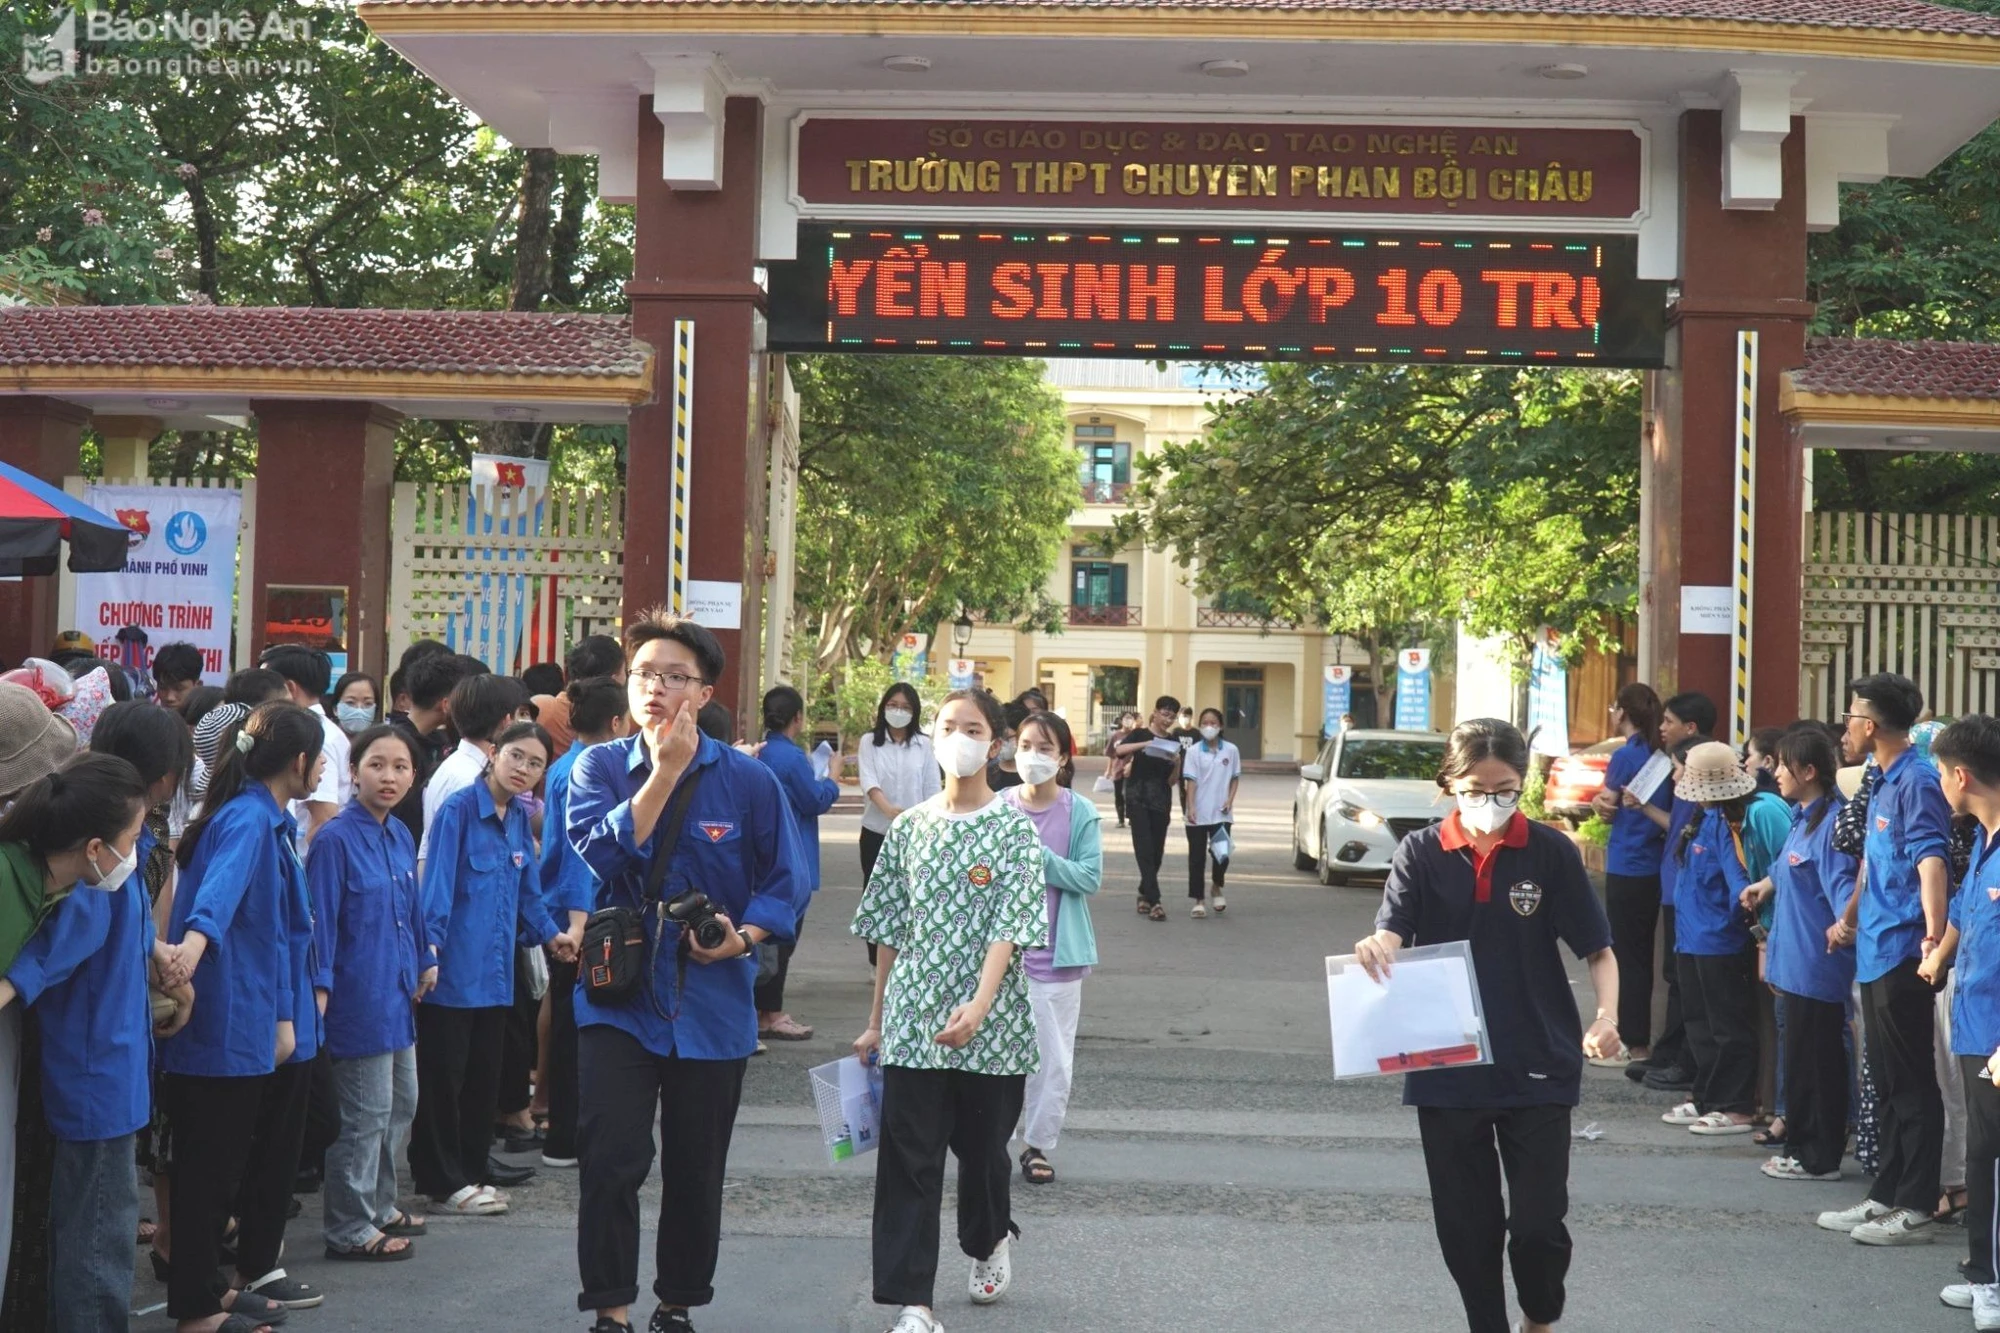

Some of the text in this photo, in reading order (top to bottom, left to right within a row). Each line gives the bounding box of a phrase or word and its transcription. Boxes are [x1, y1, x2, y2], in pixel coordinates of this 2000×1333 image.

[927, 122, 974, 148] SỞ
[983, 122, 1067, 149] GIÁO
[1080, 130, 1150, 156] DỤC
[1161, 132, 1187, 151] &
[1366, 129, 1459, 158] NGHỆ
[1468, 135, 1519, 156] AN
[845, 152, 1594, 208] TRƯỜNG THPT CHUYÊN PHAN BỘI CHÂU
[991, 262, 1176, 322] SINH
[1203, 249, 1356, 324] LỚP
[1376, 268, 1463, 326] 10
[121, 557, 209, 576] HÀNH PHỐ VINH
[99, 600, 213, 630] CHƯƠNG TRÌNH
